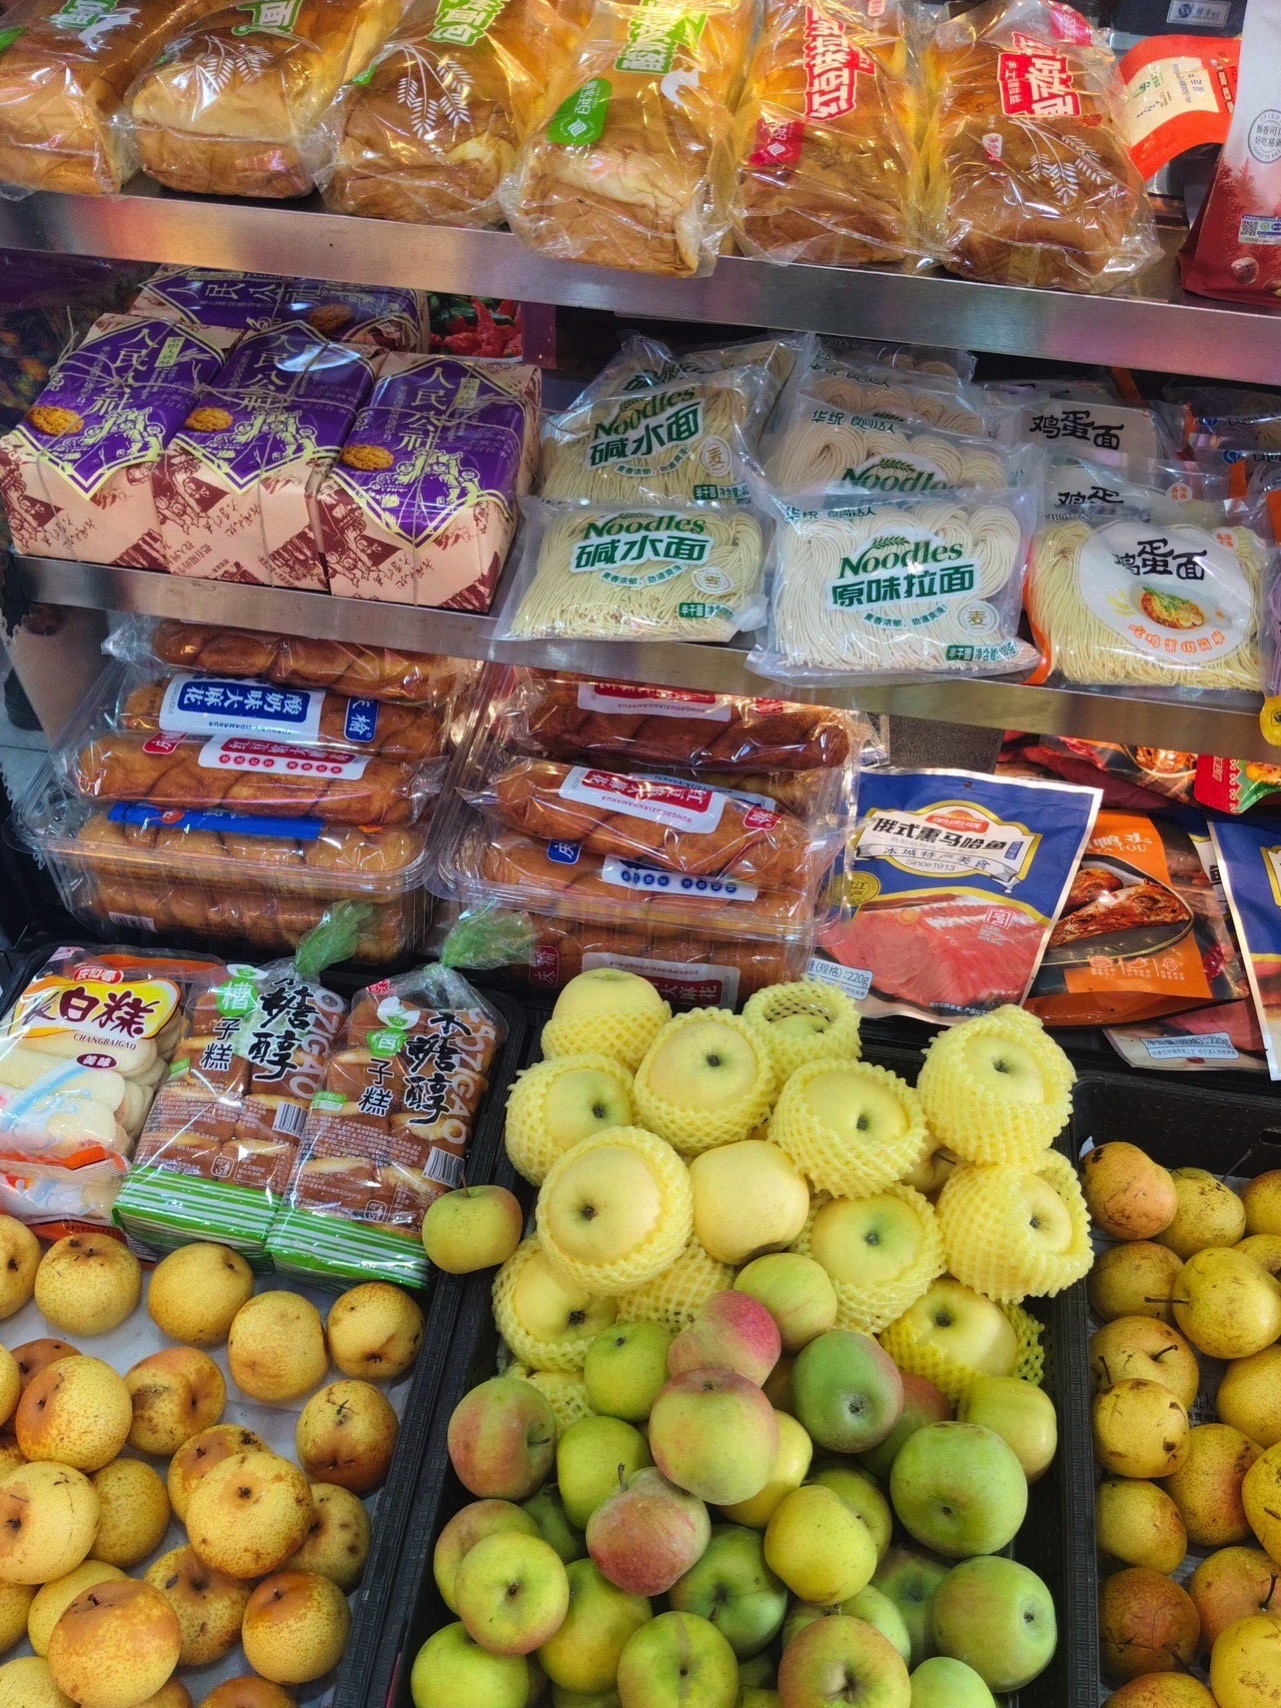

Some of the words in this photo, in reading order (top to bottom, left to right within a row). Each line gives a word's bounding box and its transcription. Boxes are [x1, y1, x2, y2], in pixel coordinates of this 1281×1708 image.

[590, 402, 701, 468] 碱水面
[1029, 410, 1125, 450] 鸡蛋面
[584, 515, 706, 540] Noodles
[574, 535, 709, 569] 碱水面
[837, 541, 963, 579] Noodles
[1113, 538, 1207, 581] 鸡蛋面
[832, 563, 974, 608] 原味拉面
[184, 686, 303, 716] 酸奶味大麻花
[872, 817, 1008, 850] 俄式熏马哈鱼
[883, 847, 991, 871] 冰城特产美食
[906, 858, 956, 872] Since1913
[652, 982, 717, 1002] 大麻花
[22, 986, 160, 1038] 长白糕
[73, 1032, 137, 1050] CHANGBAIGAO
